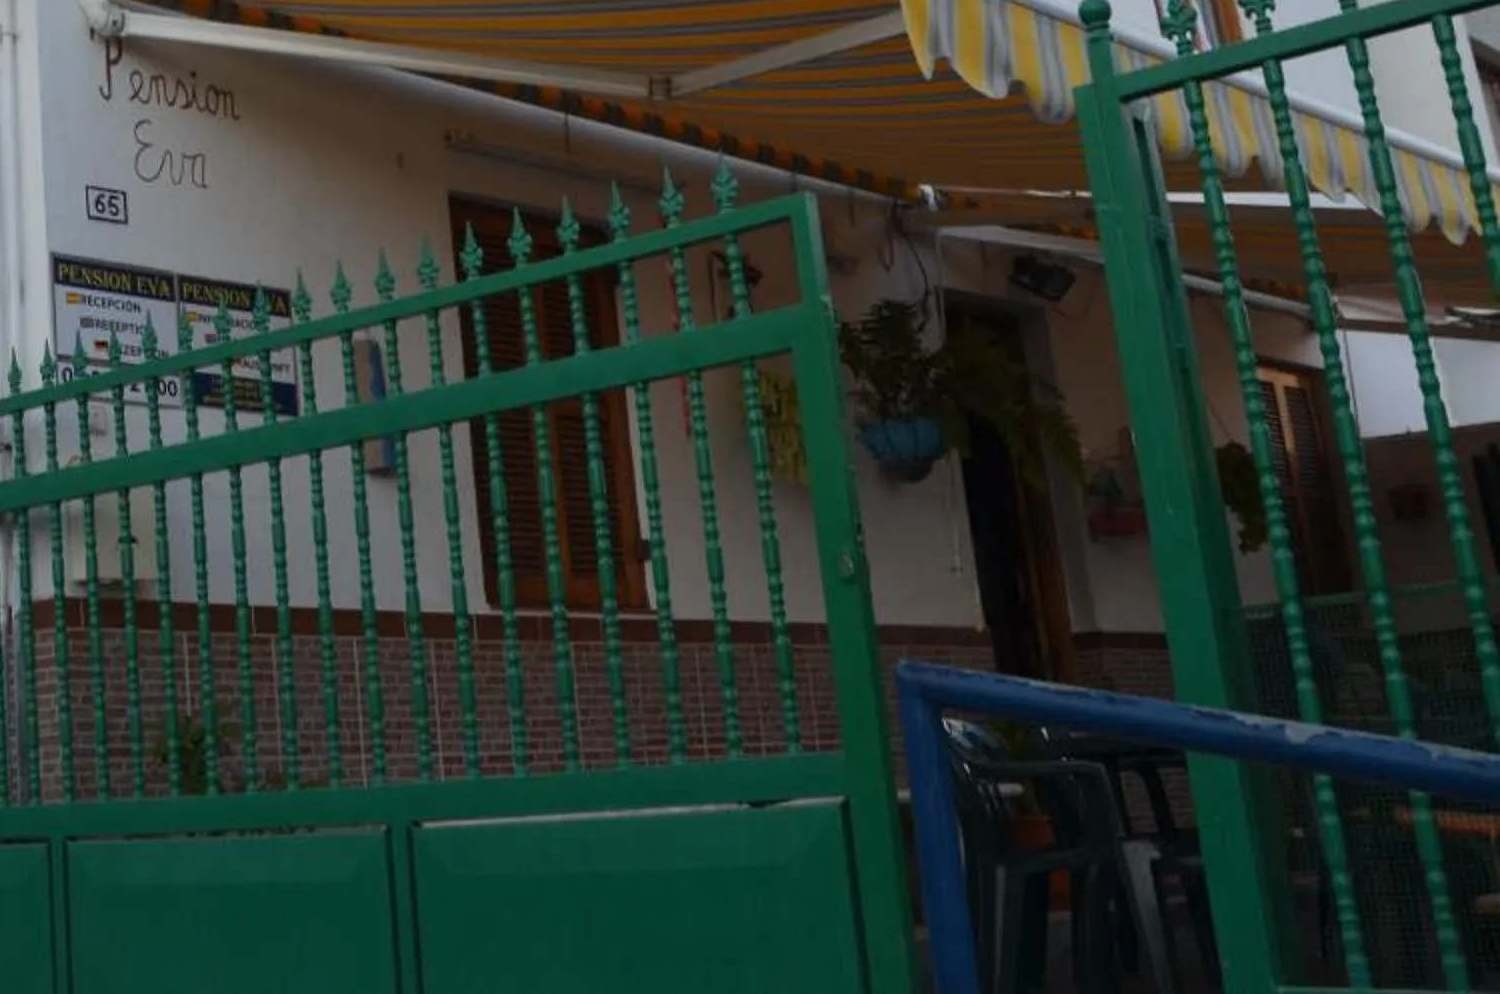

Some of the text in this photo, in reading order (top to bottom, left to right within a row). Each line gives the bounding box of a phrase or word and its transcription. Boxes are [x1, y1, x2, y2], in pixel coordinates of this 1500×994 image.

[100, 35, 240, 121] Pension
[133, 118, 209, 189] Eva
[94, 193, 121, 217] 65
[57, 262, 171, 298] PENSION EVA
[182, 282, 252, 310] PENSION
